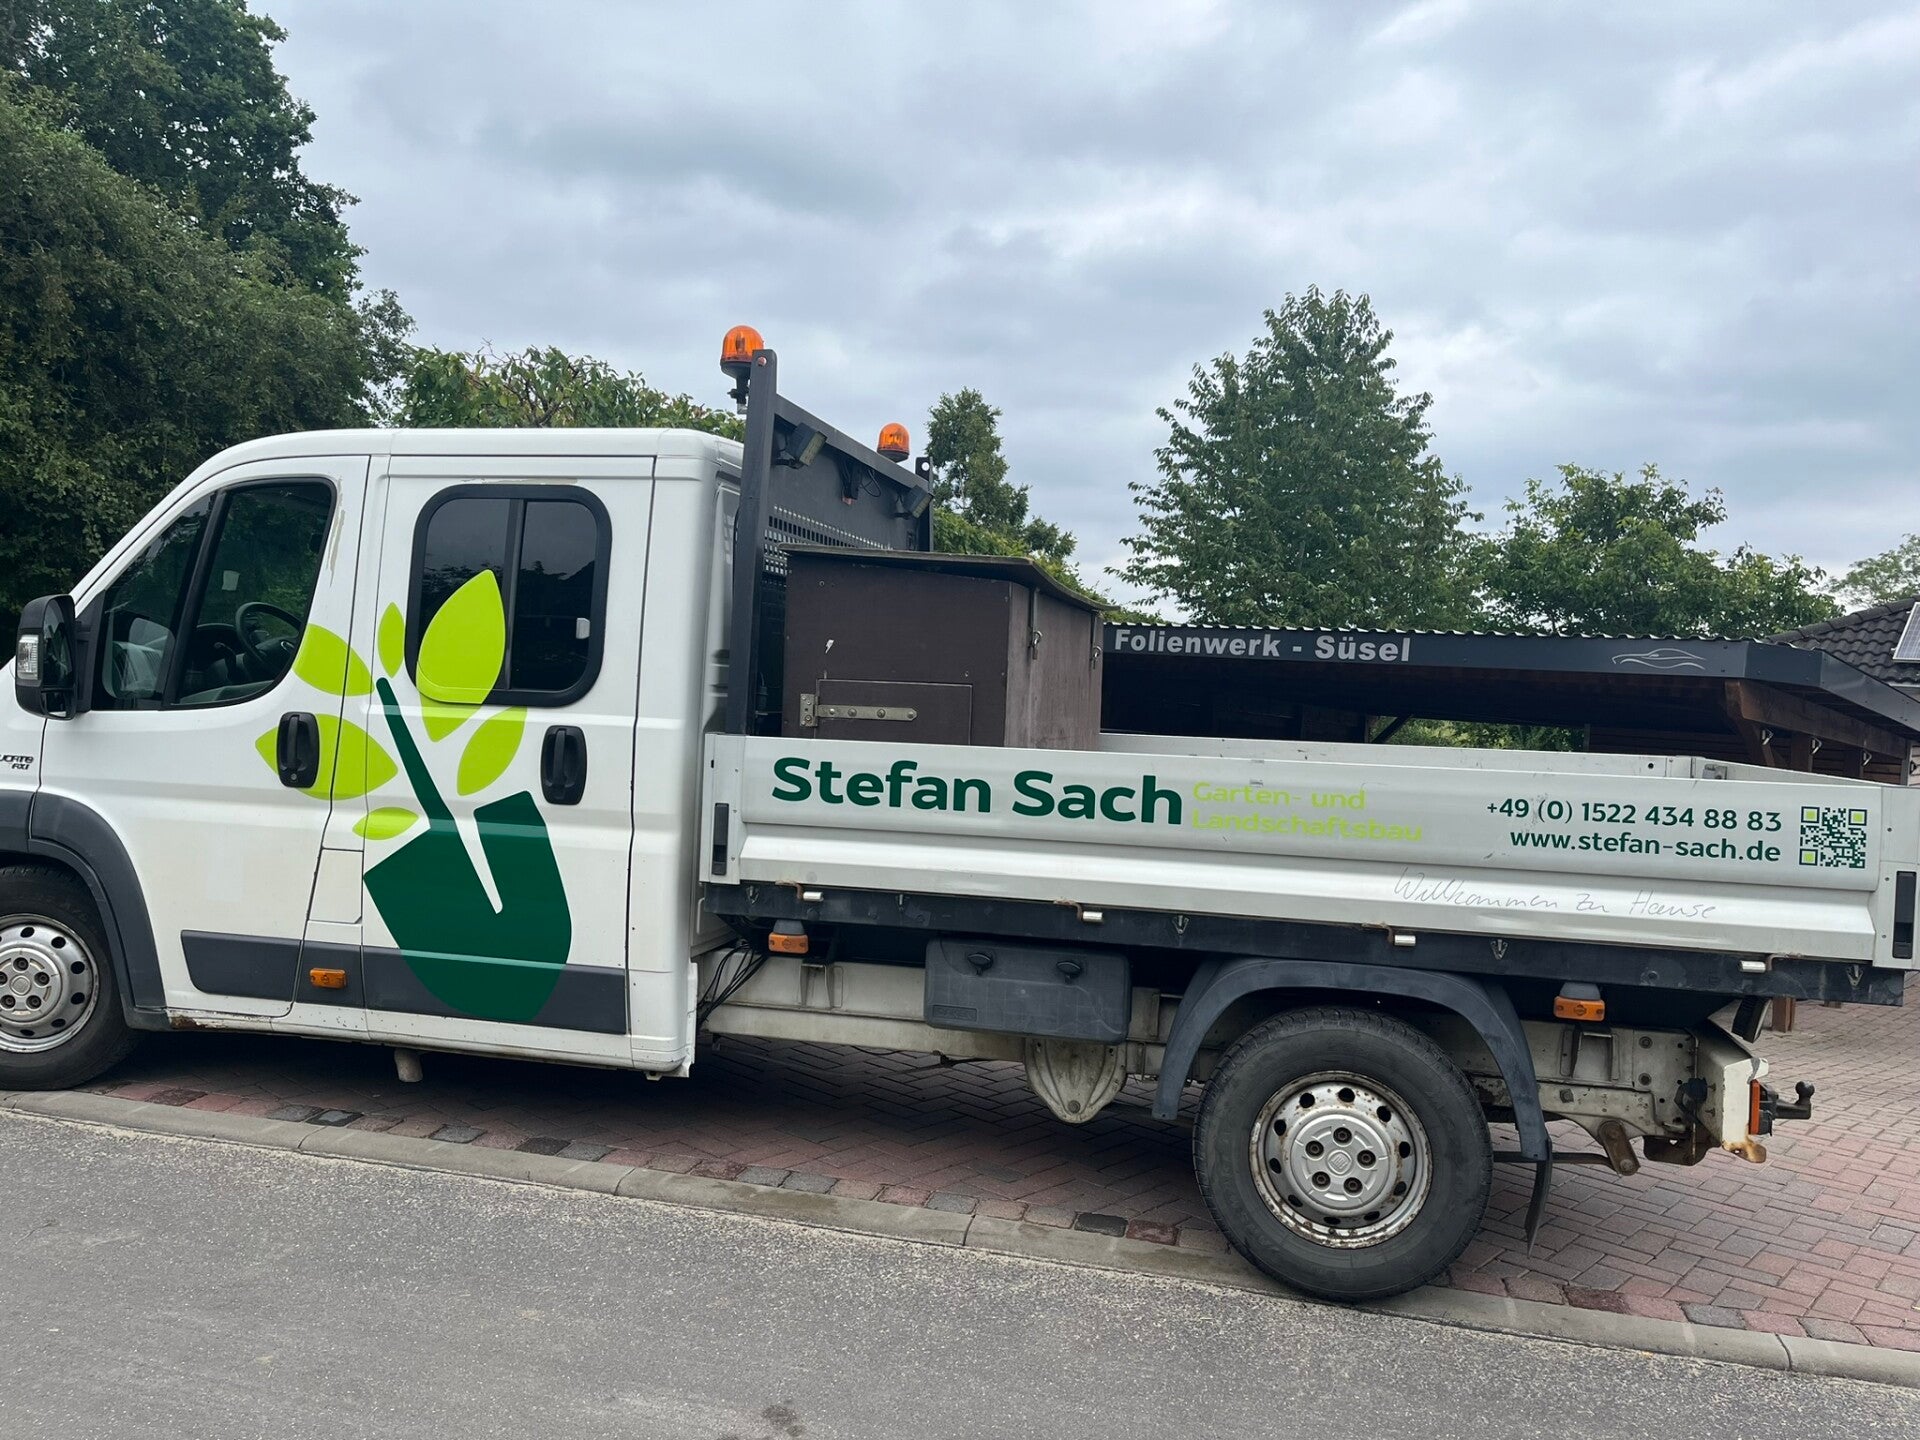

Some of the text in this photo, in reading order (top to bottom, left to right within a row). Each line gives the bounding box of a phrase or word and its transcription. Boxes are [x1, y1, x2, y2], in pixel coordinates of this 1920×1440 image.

[1115, 629, 1281, 657] Folienwerk
[1314, 635, 1411, 662] Süsel
[771, 757, 1182, 825] Stefan Sach
[1192, 781, 1367, 810] Garten- und
[1191, 808, 1424, 843] Landschaftsbau
[1486, 798, 1782, 832] +49 (0) 1522 434 88 83
[1509, 831, 1782, 862] www.stefan-sach.de
[1393, 866, 1557, 908] Willkommen
[1628, 889, 1716, 920] Hause
